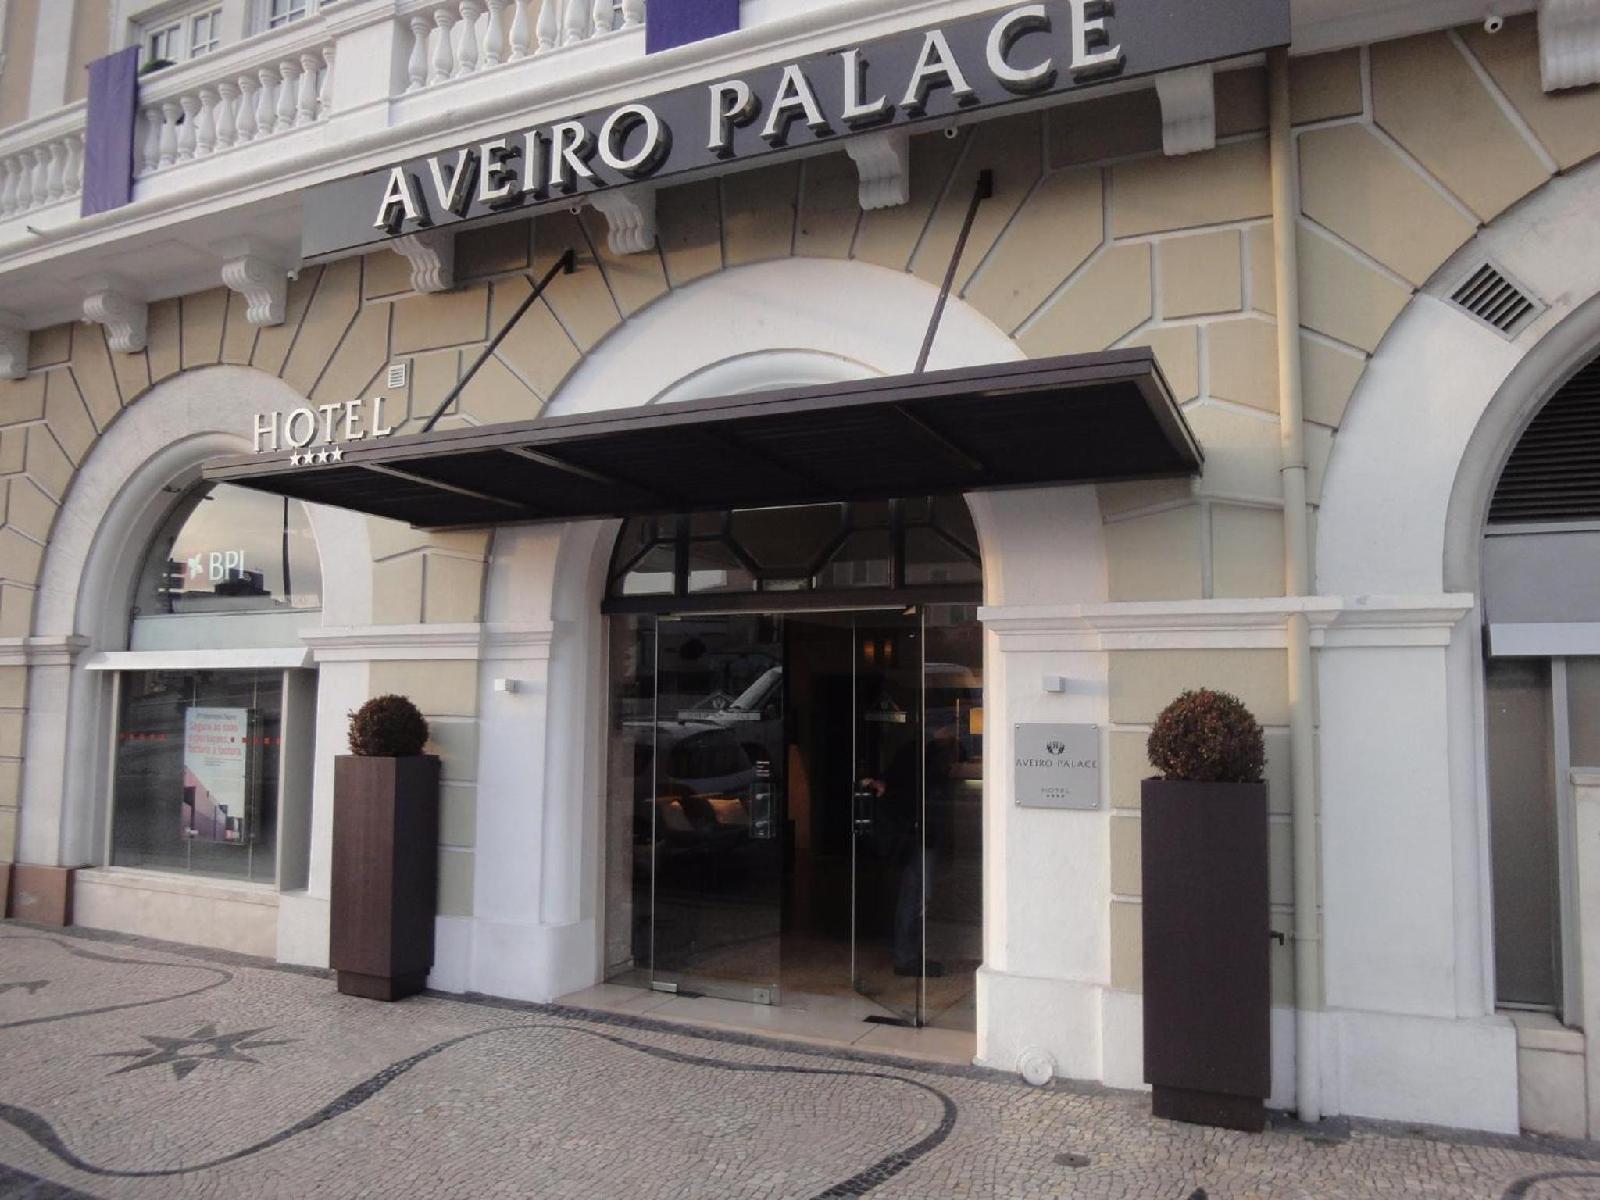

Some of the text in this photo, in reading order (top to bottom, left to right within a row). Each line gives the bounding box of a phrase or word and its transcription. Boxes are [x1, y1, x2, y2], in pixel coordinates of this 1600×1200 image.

[373, 0, 1122, 230] AVEIRO PALACE
[254, 397, 392, 453] HOTEL
[208, 550, 245, 581] BPI
[1015, 759, 1098, 769] AVEIRO PALACE
